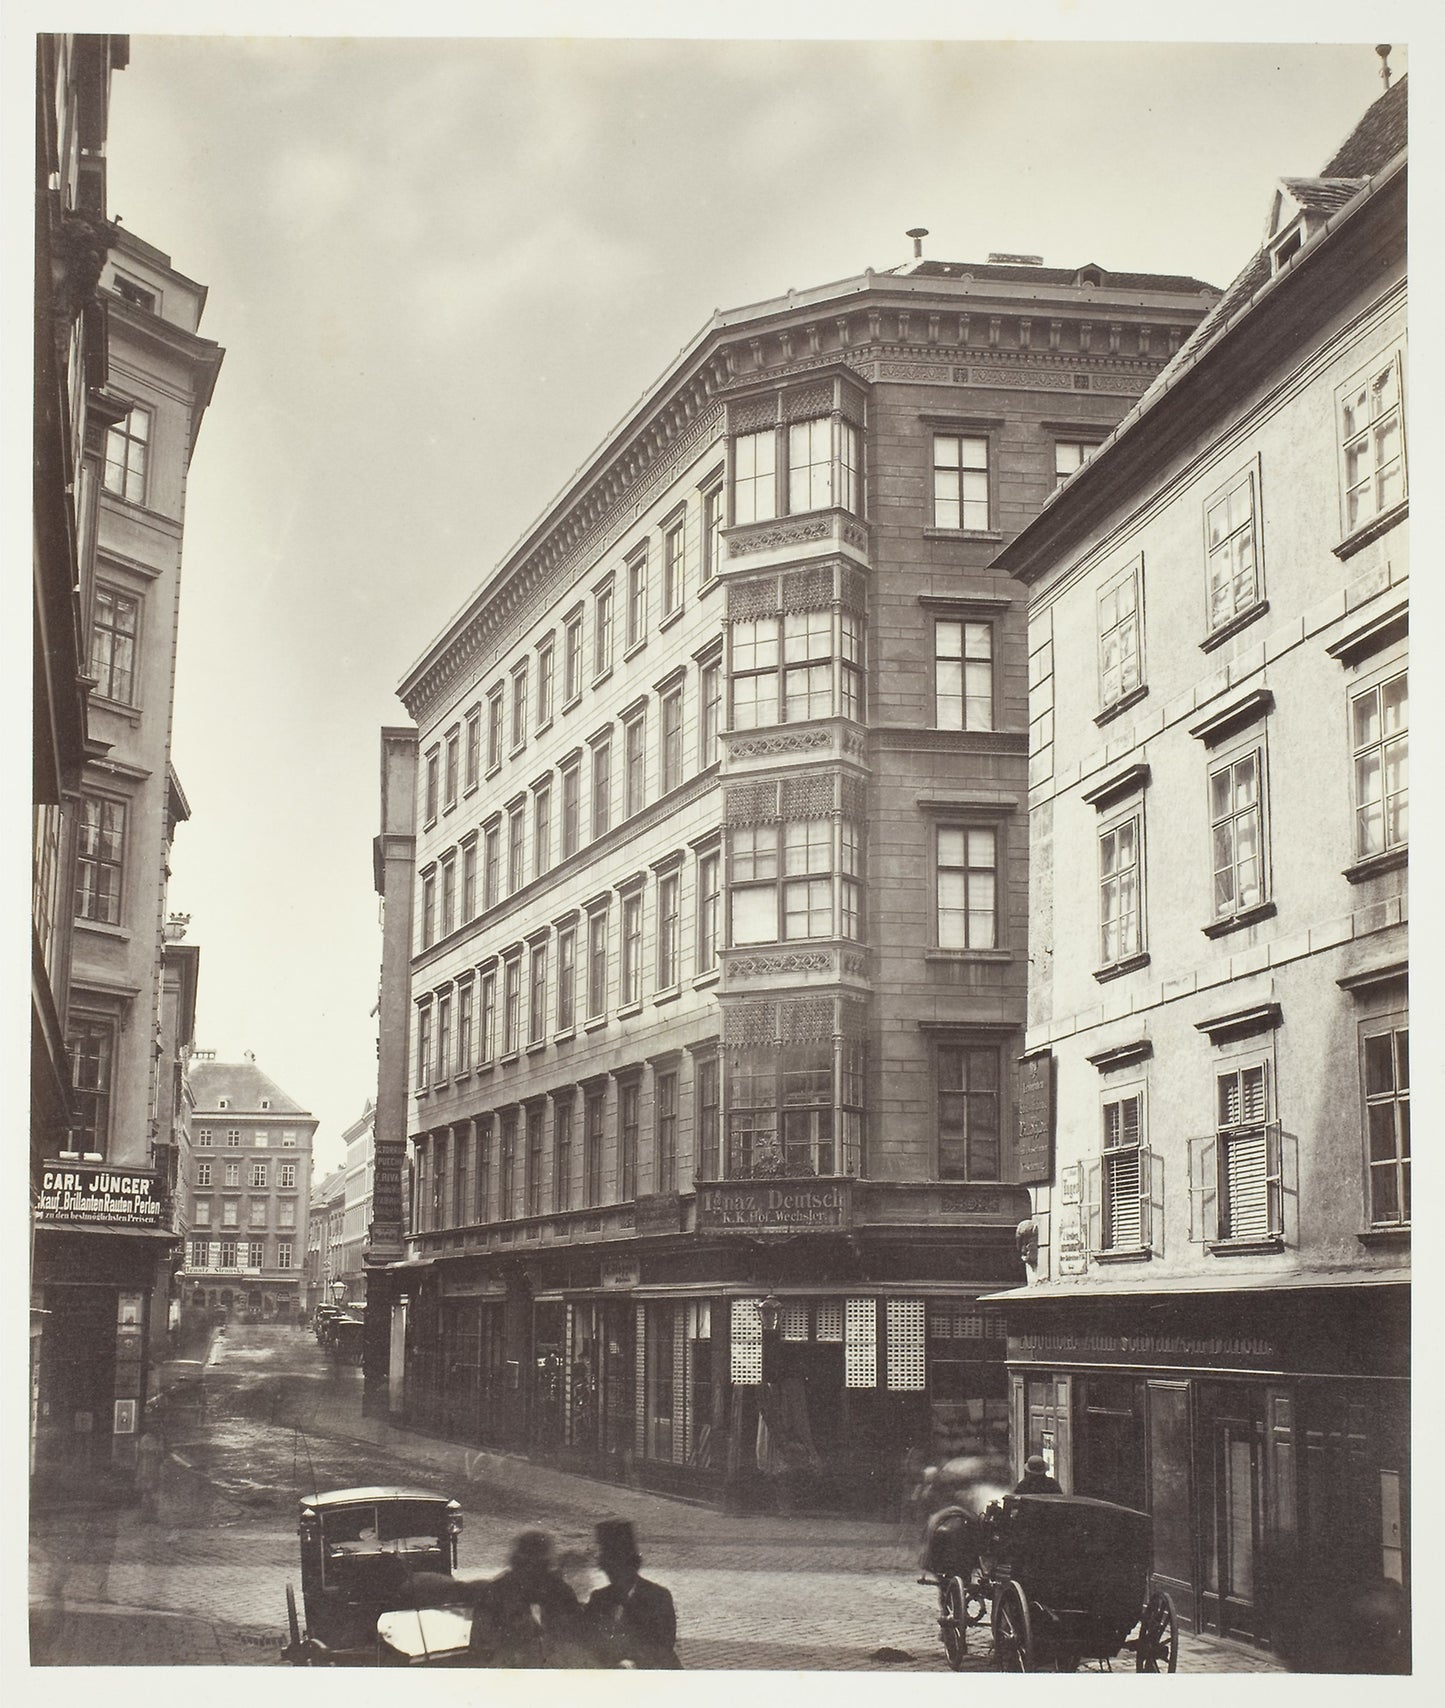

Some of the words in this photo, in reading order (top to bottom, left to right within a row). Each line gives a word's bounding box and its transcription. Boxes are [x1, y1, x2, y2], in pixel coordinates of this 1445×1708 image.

[43, 1172, 83, 1191] CARL
[704, 1189, 756, 1214] Ignaz
[767, 1186, 844, 1210] Deutsch
[55, 1211, 69, 1219] den
